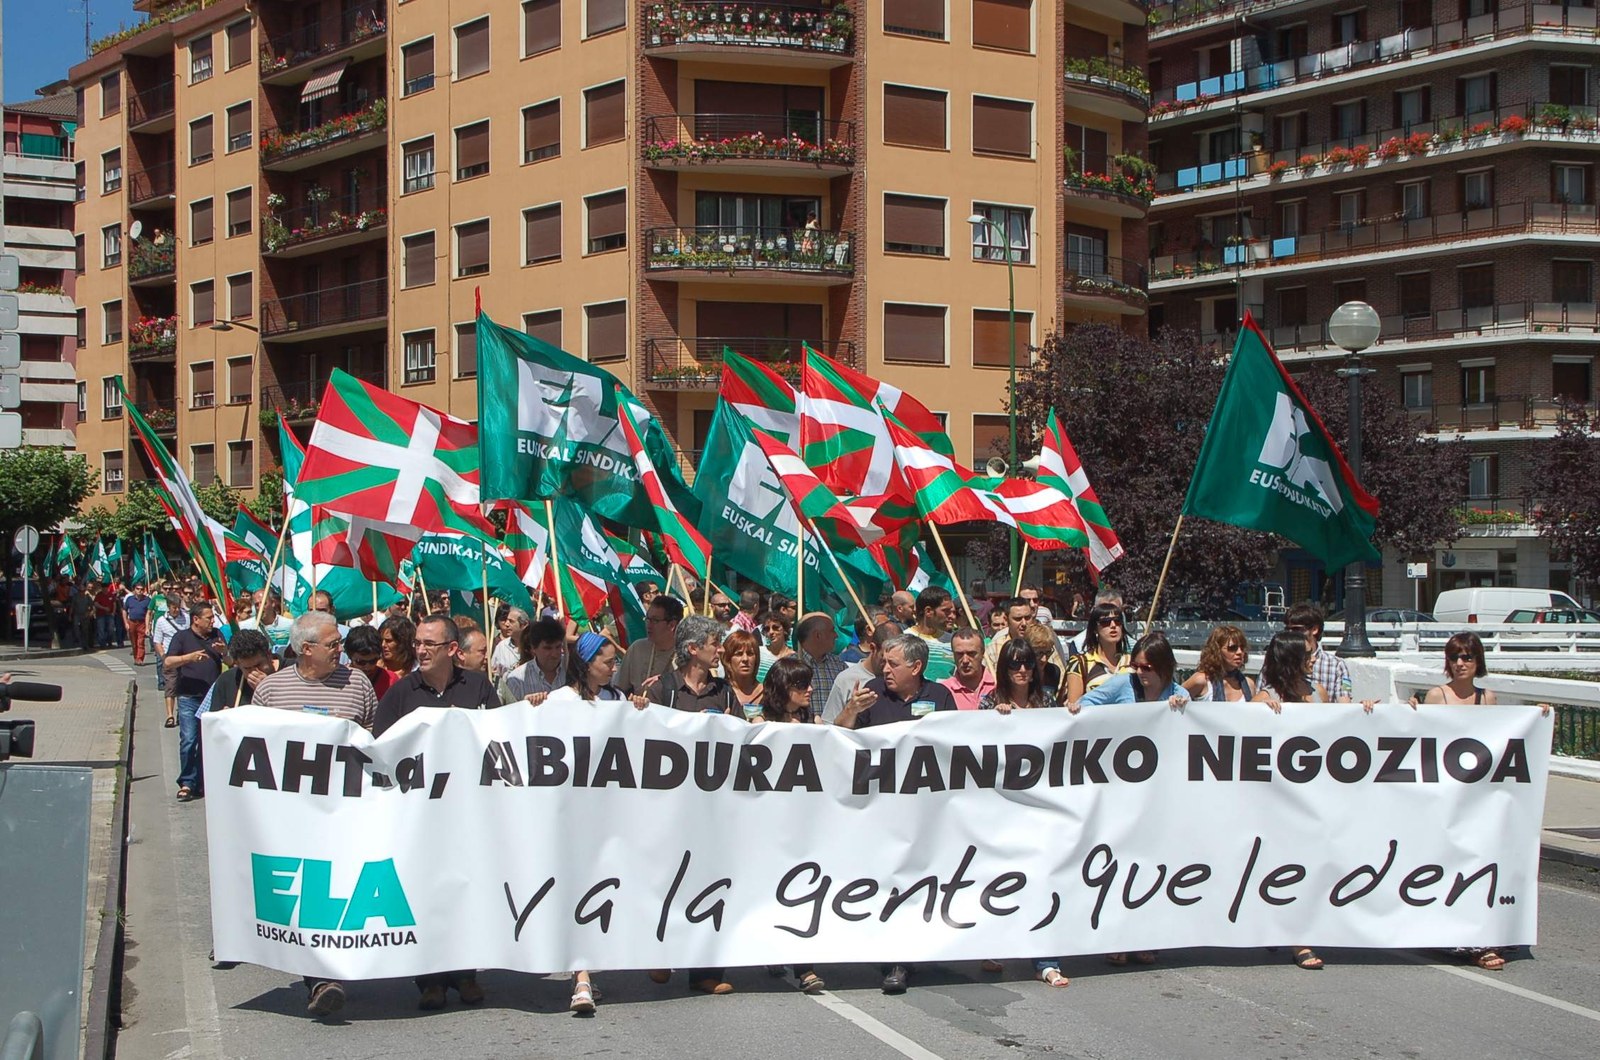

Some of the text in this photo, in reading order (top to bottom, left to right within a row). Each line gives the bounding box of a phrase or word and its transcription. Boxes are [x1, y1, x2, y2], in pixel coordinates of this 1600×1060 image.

[517, 438, 571, 462] EUSKAL
[721, 505, 774, 546] EUSKAL
[480, 735, 824, 792] ABIADURA
[851, 735, 1159, 796] HANDIKO
[1188, 734, 1531, 784] NEGOZIOA
[251, 852, 417, 931] ELA
[575, 877, 620, 934] a
[656, 849, 732, 942] la
[1082, 843, 1212, 930] que
[1228, 836, 1306, 923] le
[256, 924, 418, 949] EUSKAL SINDIKATUA
